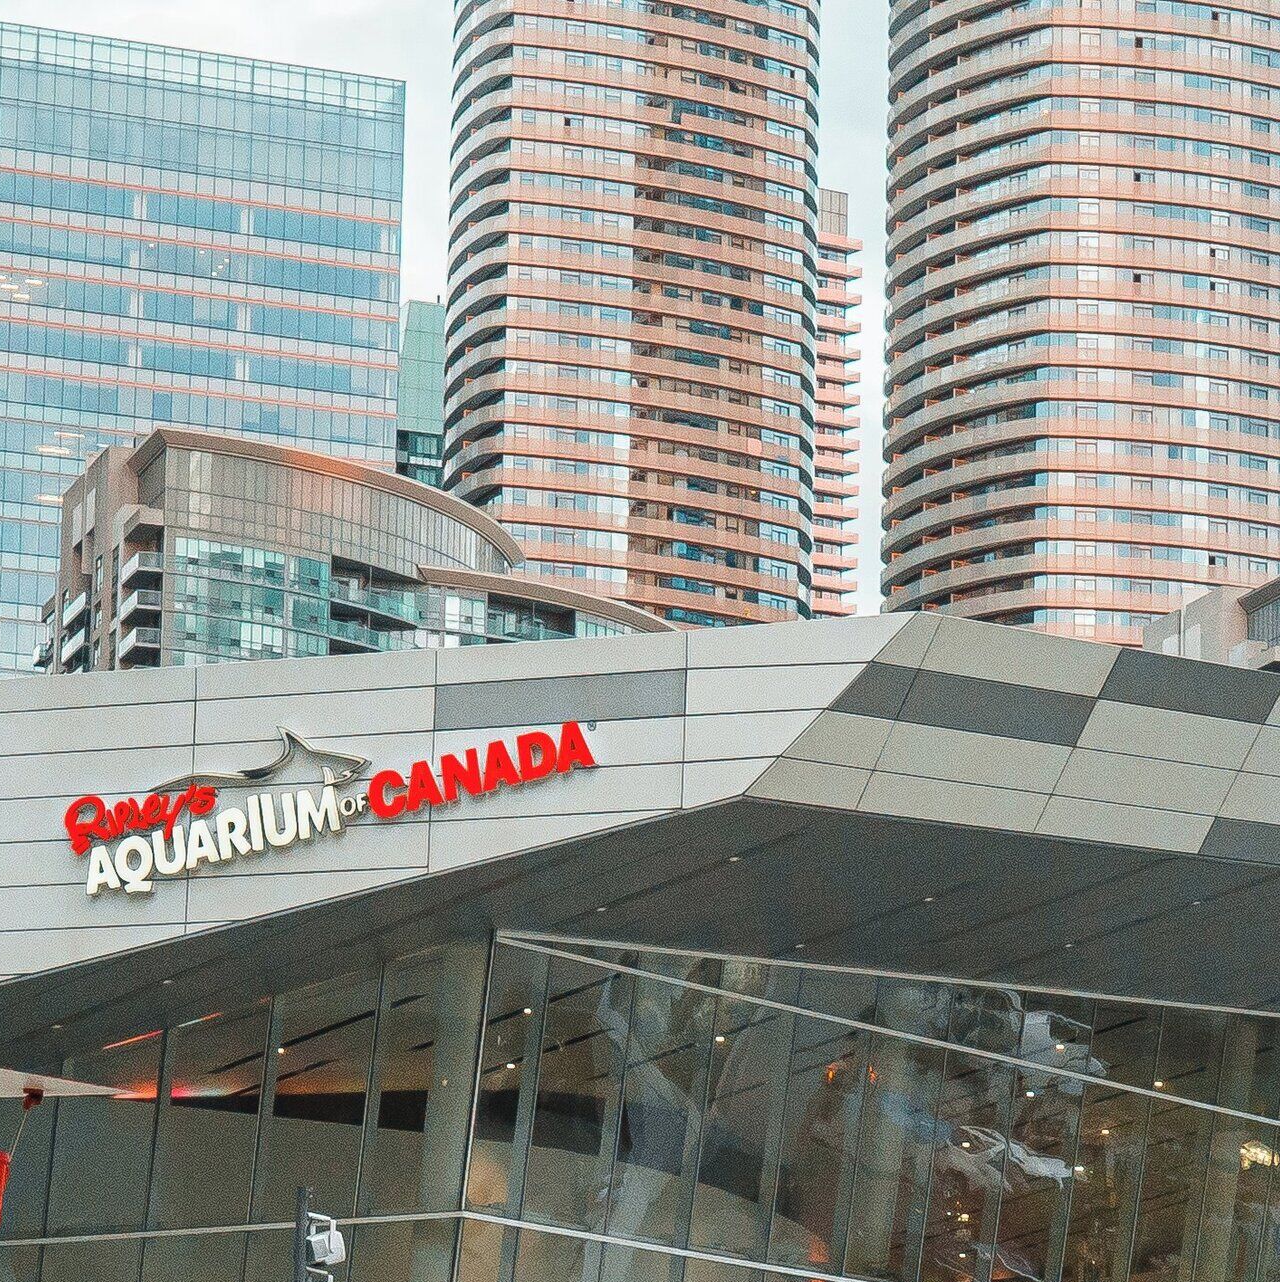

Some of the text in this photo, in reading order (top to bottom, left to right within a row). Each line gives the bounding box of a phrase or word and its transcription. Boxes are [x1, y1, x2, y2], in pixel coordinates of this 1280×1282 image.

[65, 783, 217, 855] Ripley's
[86, 721, 595, 896] AQUARIUM OF CANADA
